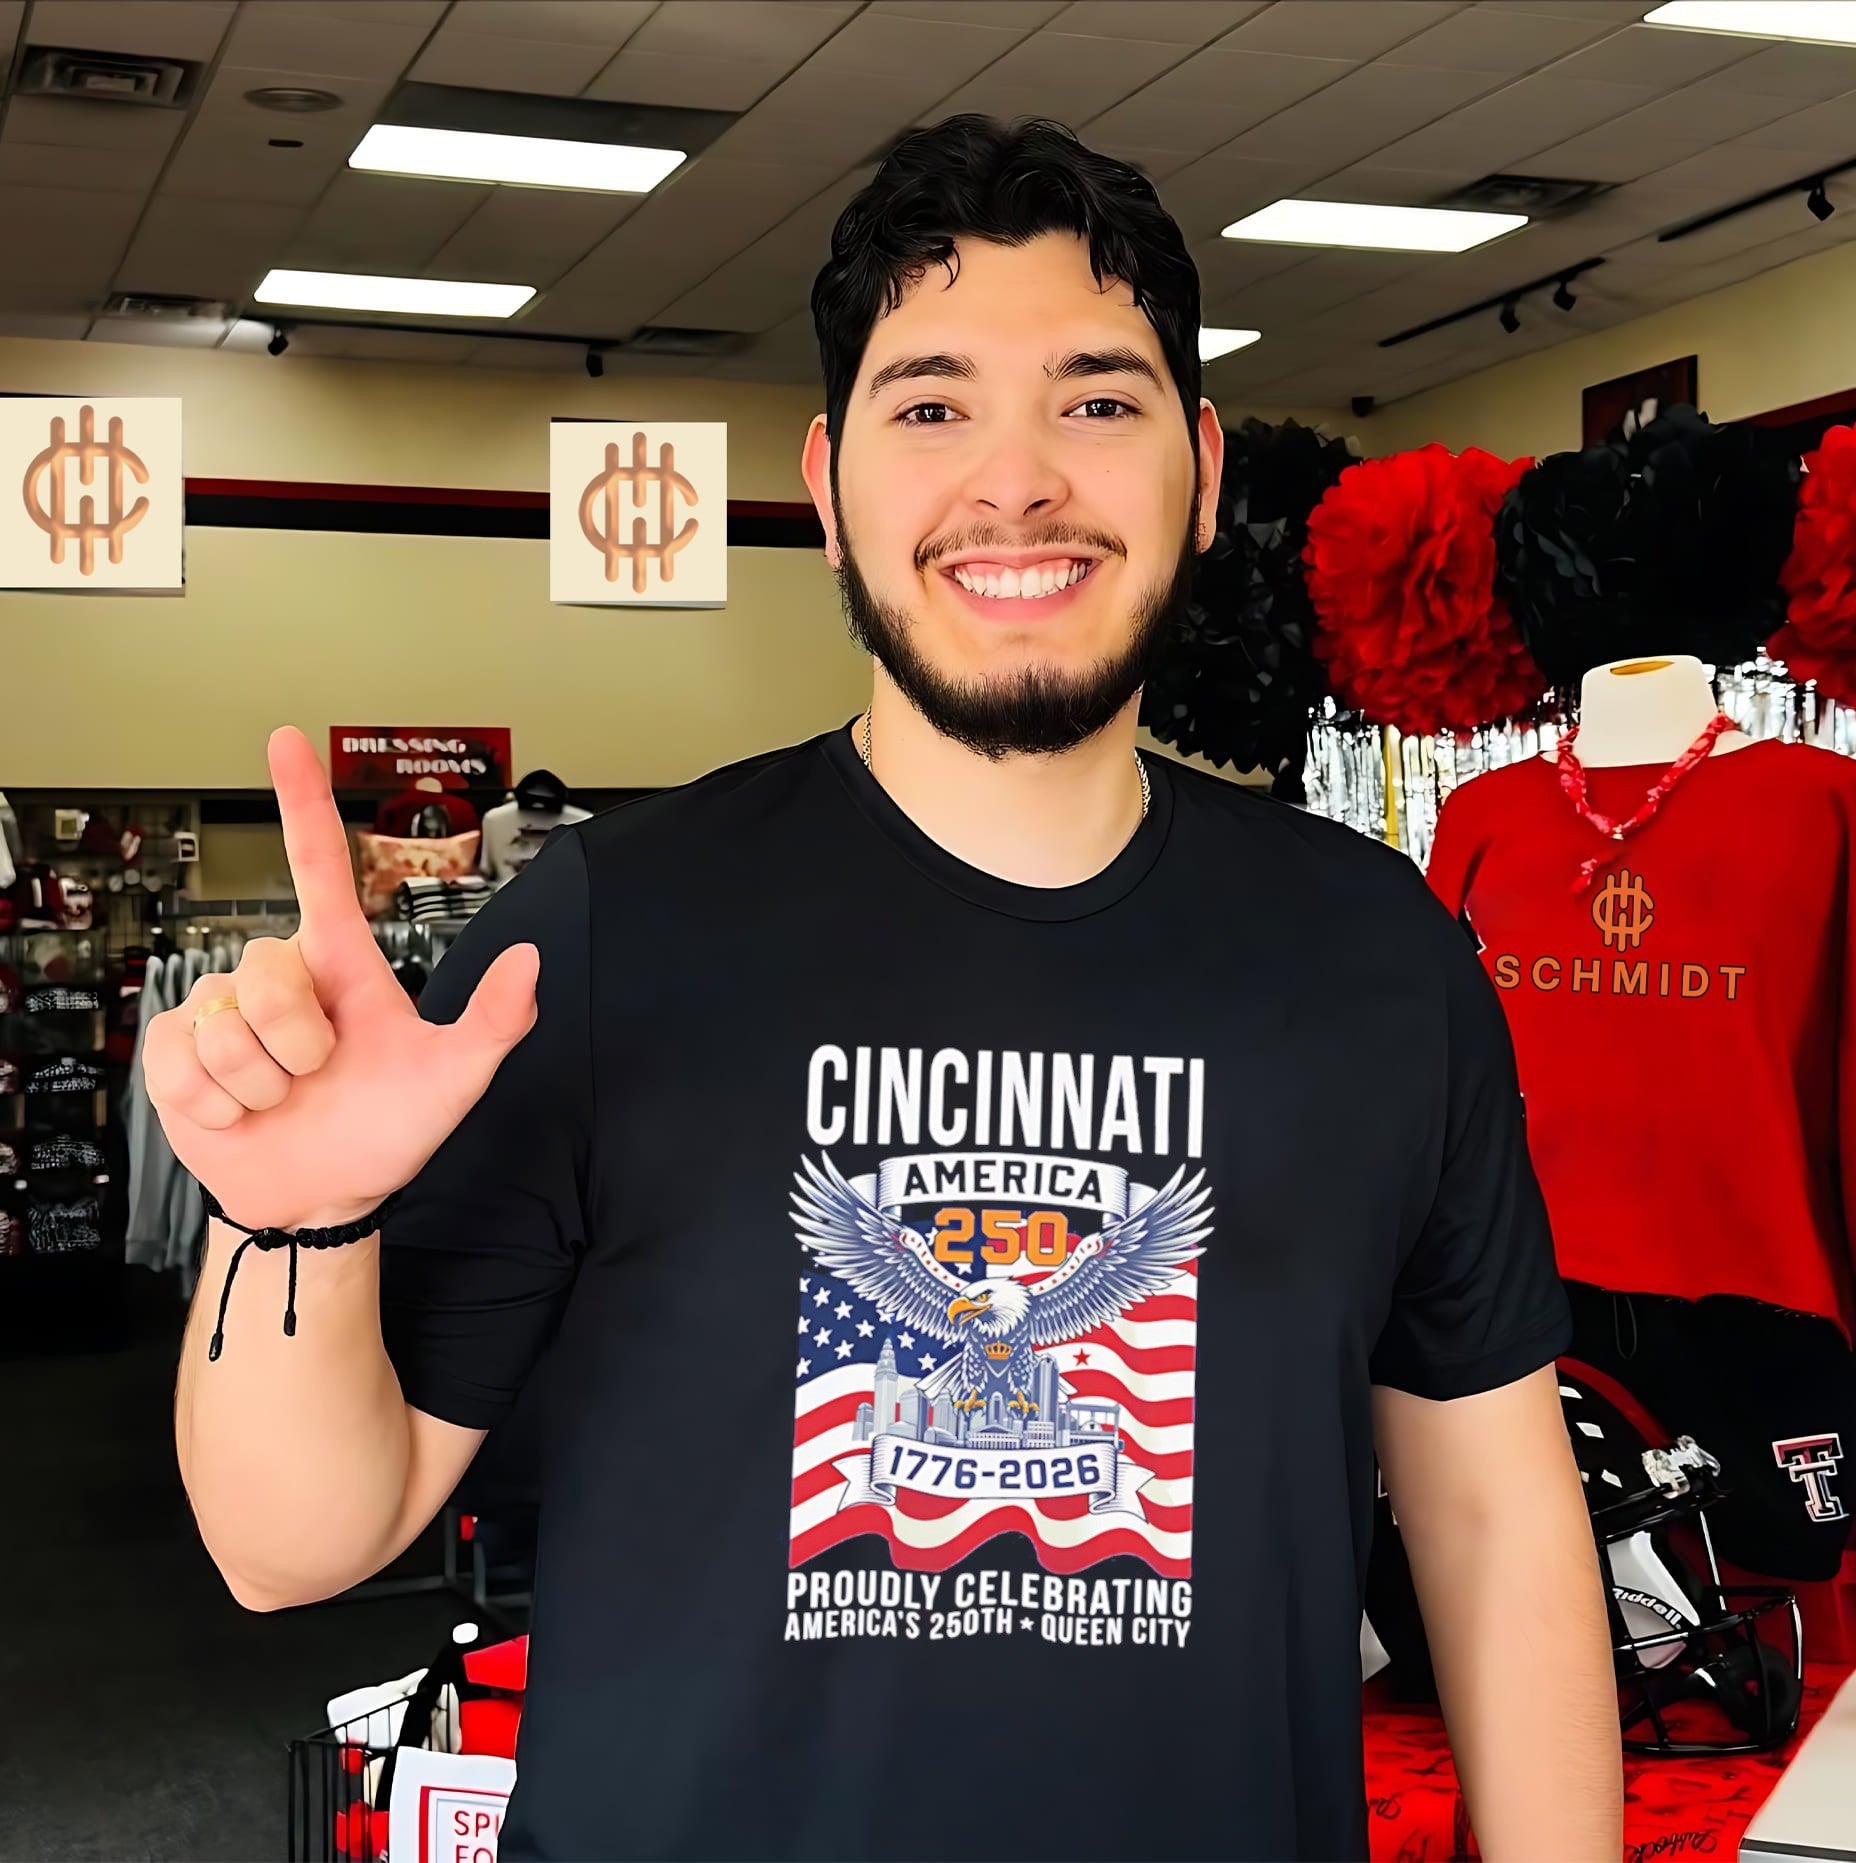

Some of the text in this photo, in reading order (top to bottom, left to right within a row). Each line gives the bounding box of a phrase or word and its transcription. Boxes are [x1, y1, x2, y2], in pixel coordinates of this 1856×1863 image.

[342, 737, 467, 753] DRESSING
[396, 758, 487, 775] ROOMS
[1494, 954, 1746, 1000] SCHMIDT
[806, 1044, 1205, 1158] CINCINNATI
[903, 1159, 1103, 1203] AMERICA
[933, 1207, 1069, 1266] 250
[889, 1445, 1101, 1490] 1776-2026
[786, 1569, 1193, 1619] PROUDLY CELEBRATING
[1612, 1587, 1682, 1626] Riddell
[784, 1607, 1192, 1648] AMERICA'S 250TH QUEEN CITY
